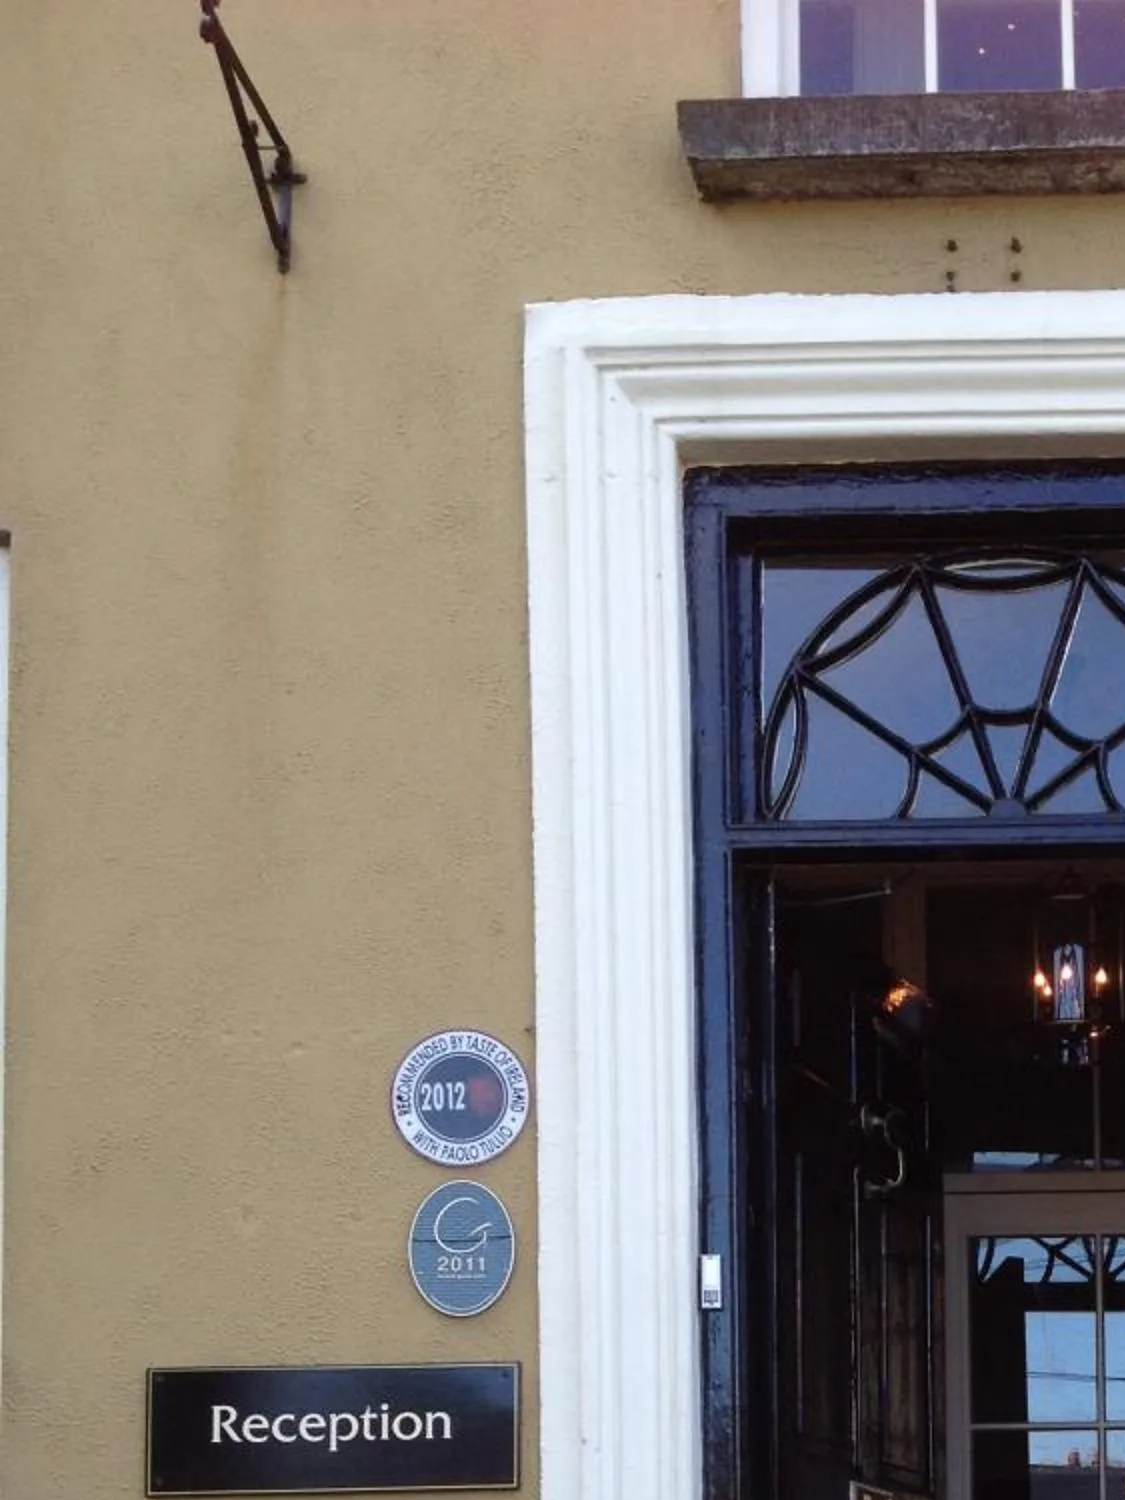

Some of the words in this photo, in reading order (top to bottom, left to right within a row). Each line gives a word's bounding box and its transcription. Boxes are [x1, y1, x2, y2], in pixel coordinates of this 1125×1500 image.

[396, 1038, 448, 1116] RECOMMENDED
[449, 1035, 464, 1050] BY
[466, 1035, 497, 1057] TASTE
[495, 1050, 513, 1068] OF
[420, 1081, 467, 1112] 2012
[411, 1128, 439, 1155] WITH
[439, 1143, 479, 1161] PAOLO
[437, 1256, 486, 1272] 2011
[209, 1402, 453, 1453] Reception
